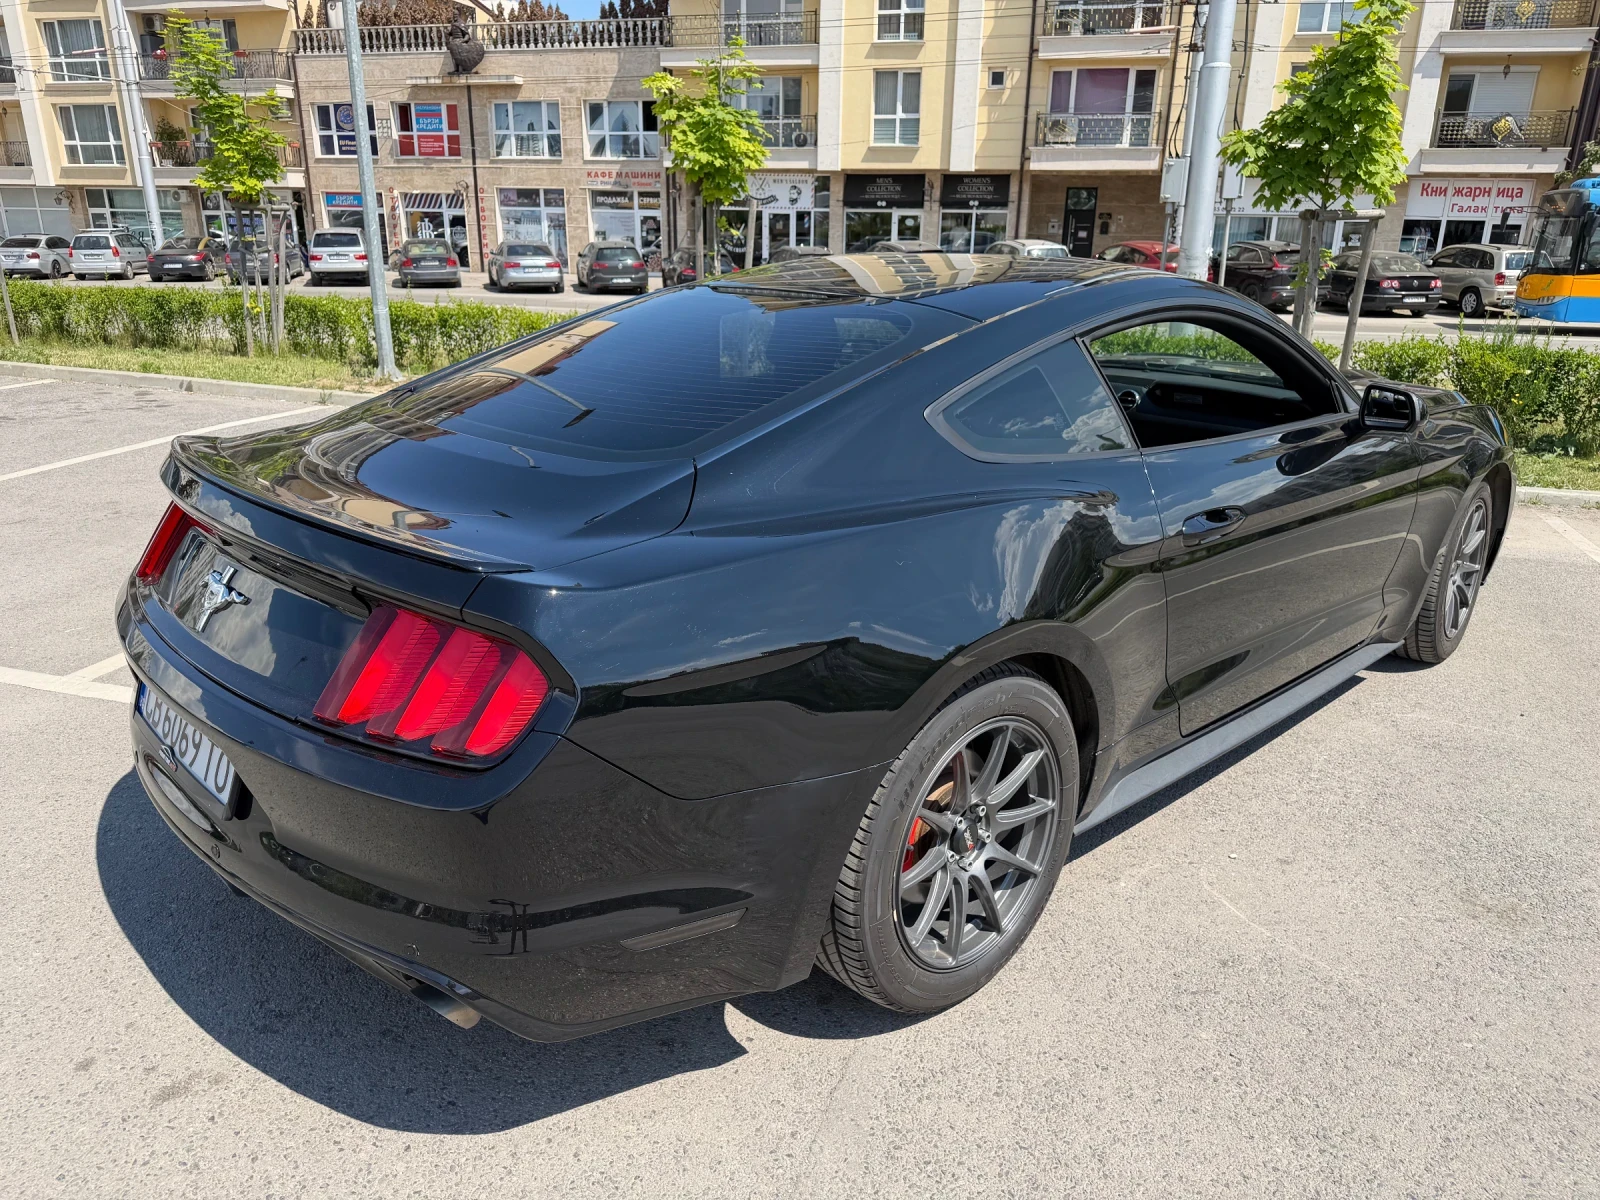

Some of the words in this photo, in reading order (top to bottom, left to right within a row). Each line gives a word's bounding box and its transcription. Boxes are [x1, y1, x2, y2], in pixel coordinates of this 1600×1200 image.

[587, 171, 614, 179] КАФЕ
[615, 171, 661, 179] МАШИНИ
[1420, 183, 1524, 202] Книжарница
[596, 196, 630, 204] ПРОДАЖБА
[388, 186, 401, 256] ОТВОРЕН
[479, 187, 490, 259] ОТВОРЕНО
[162, 704, 203, 768] 6069
